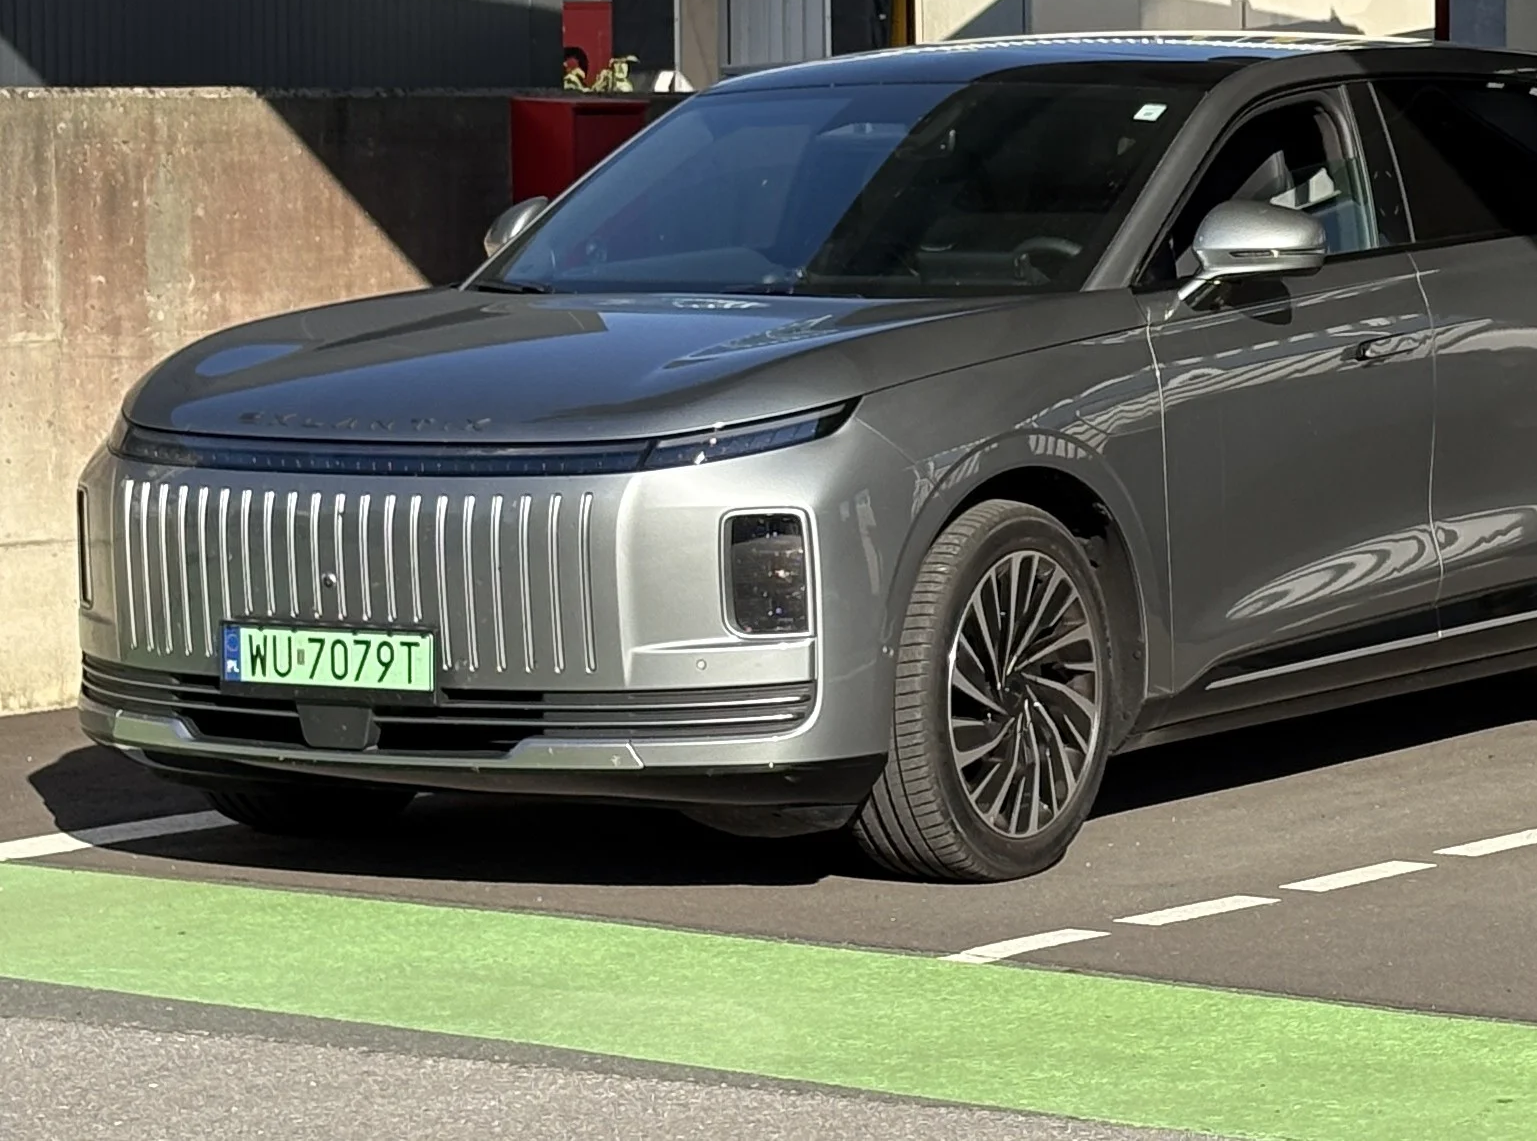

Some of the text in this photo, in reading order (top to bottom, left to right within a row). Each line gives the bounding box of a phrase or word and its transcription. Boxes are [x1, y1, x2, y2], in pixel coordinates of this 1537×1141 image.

[226, 659, 240, 674] PL
[248, 634, 421, 684] WU 7079T
